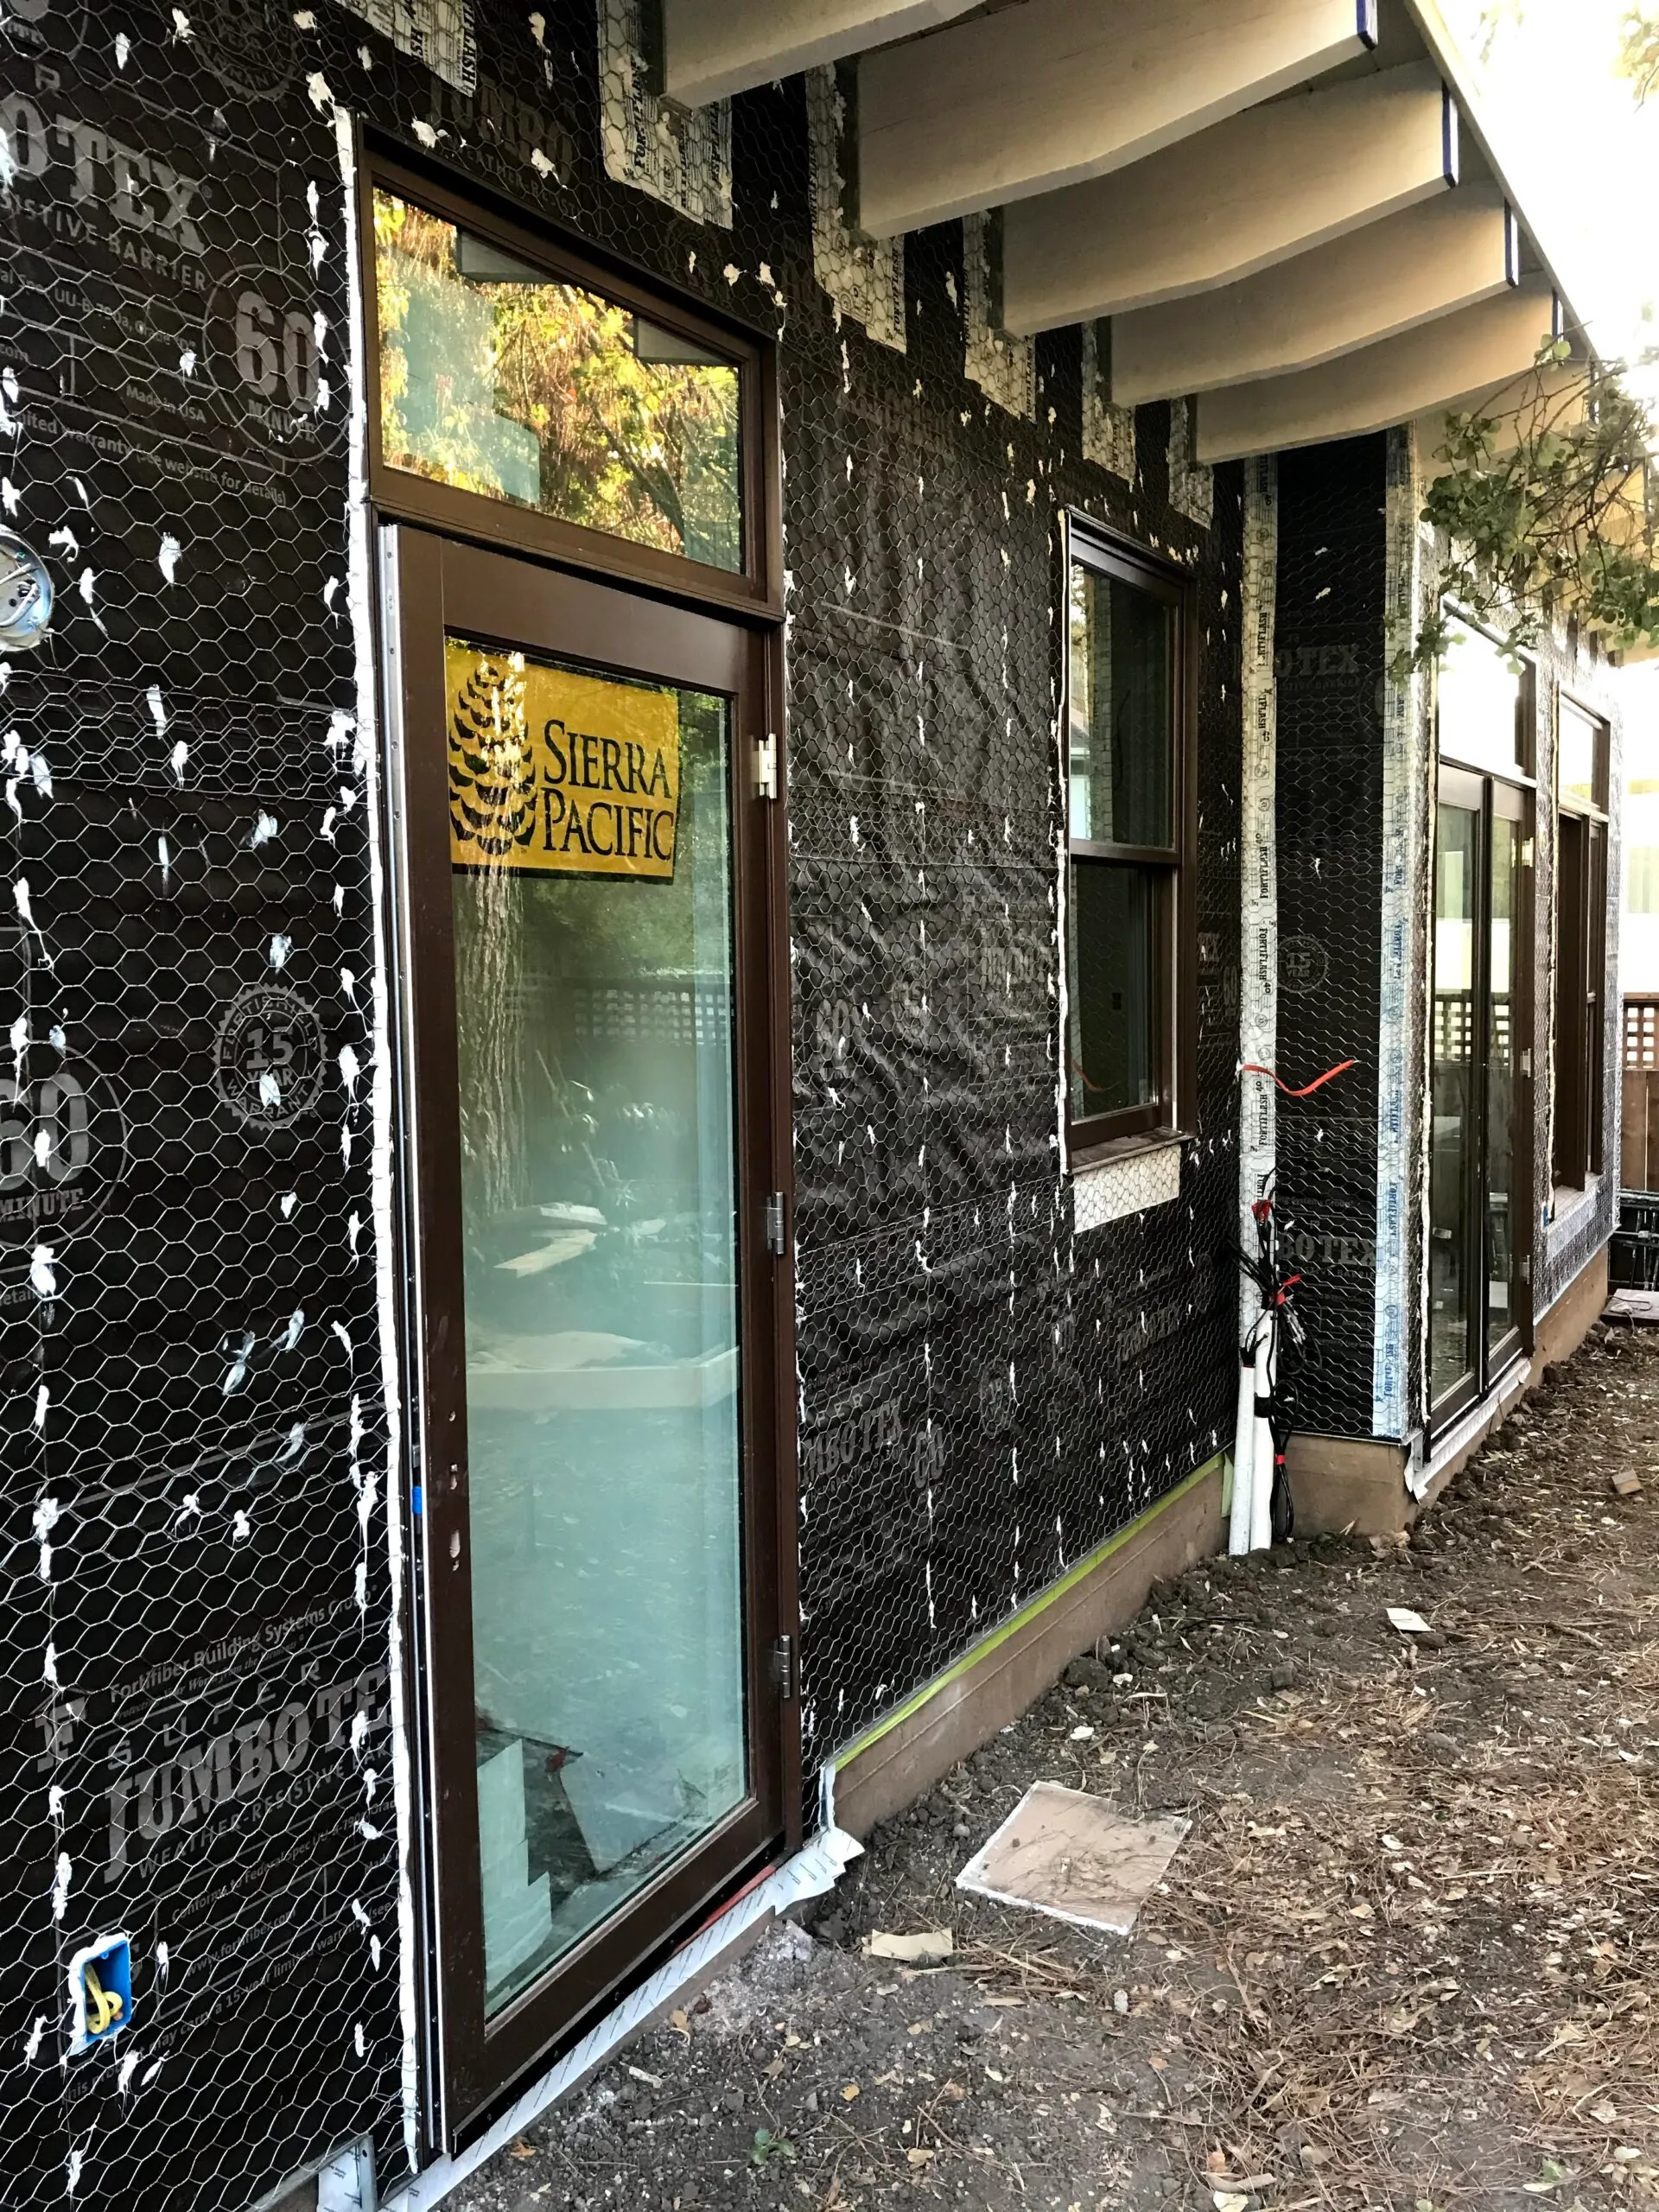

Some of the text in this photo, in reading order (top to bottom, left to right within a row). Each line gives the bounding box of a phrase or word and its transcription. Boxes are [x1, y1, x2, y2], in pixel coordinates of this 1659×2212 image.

[236, 290, 320, 412] 60
[179, 403, 207, 424] USA
[220, 473, 242, 491] for
[541, 787, 674, 861] PACIFIC
[1258, 927, 1272, 994] FORTIFLASH 40
[246, 1026, 295, 1070] 15
[247, 1067, 295, 1090] YAR
[1258, 1093, 1268, 1146] FORTIFLASH
[194, 1634, 261, 1669] Building
[264, 1605, 326, 1644] Systems
